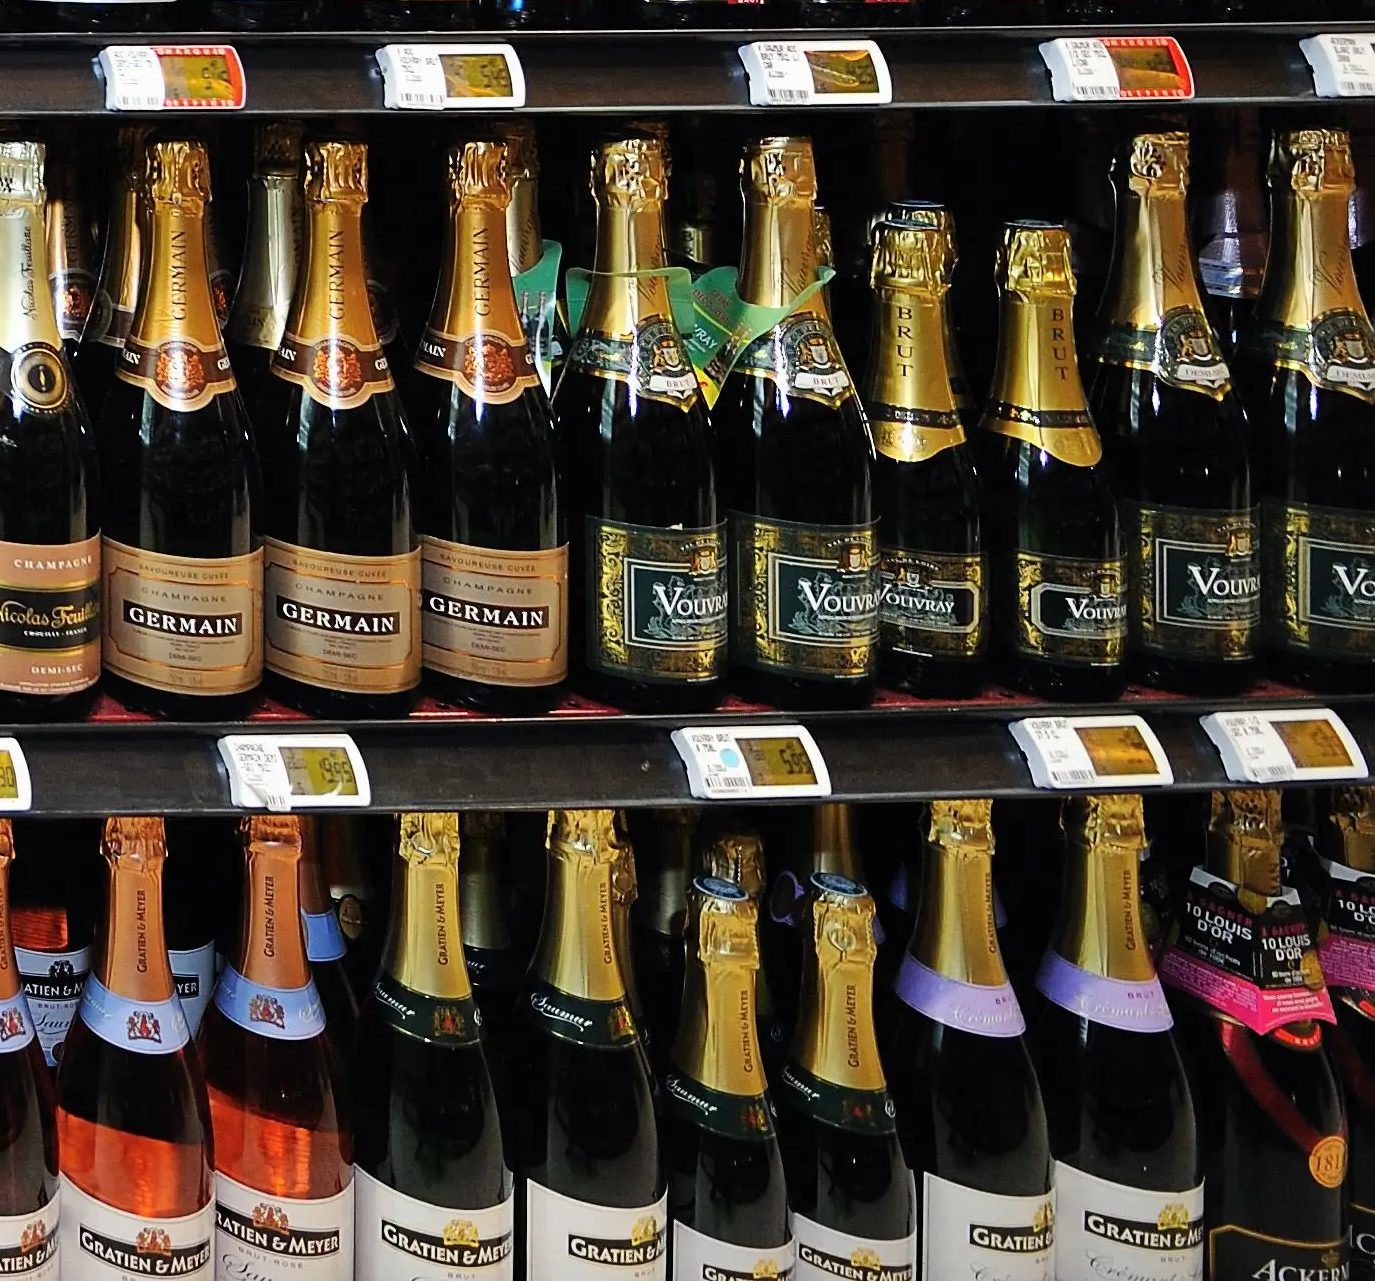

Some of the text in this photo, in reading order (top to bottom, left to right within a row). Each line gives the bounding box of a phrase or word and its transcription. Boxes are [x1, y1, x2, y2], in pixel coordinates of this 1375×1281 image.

[171, 227, 187, 321] GERMAIN
[473, 225, 490, 318] GERMAIN
[897, 306, 915, 378] BRUT
[440, 553, 502, 570] SAVOUREUSE
[444, 576, 533, 596] CHAMPAGNE
[429, 595, 544, 627] GERMAIN
[264, 876, 275, 909] MEYER
[264, 918, 275, 958] GRATIEN
[1185, 902, 1253, 941] 10 LOUIS
[1262, 933, 1311, 950] 10 LOUIS
[383, 1223, 477, 1263] GRATIEN &
[1087, 1213, 1187, 1247] GRATIEN &
[35, 1249, 47, 1268] &
[82, 1235, 152, 1272] GRATIEN
[155, 1260, 169, 1272] &
